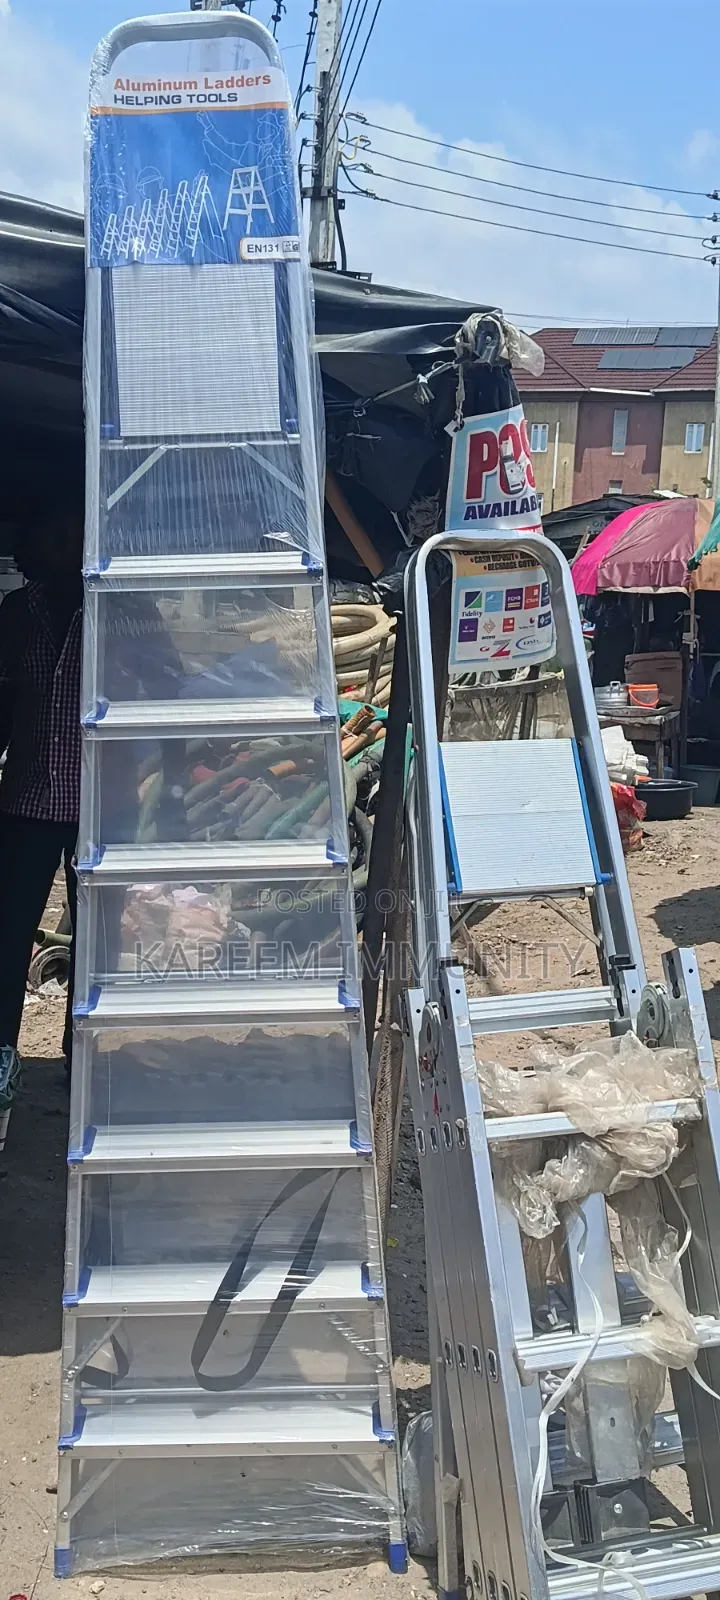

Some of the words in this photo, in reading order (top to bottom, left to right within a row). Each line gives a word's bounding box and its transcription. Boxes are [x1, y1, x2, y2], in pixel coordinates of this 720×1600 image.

[114, 78, 198, 92] Aluminum
[204, 74, 271, 89] Ladders
[114, 94, 182, 106] HELPING
[187, 92, 238, 104] TOOLS
[246, 243, 279, 253] EN131
[474, 555, 491, 563] CASH
